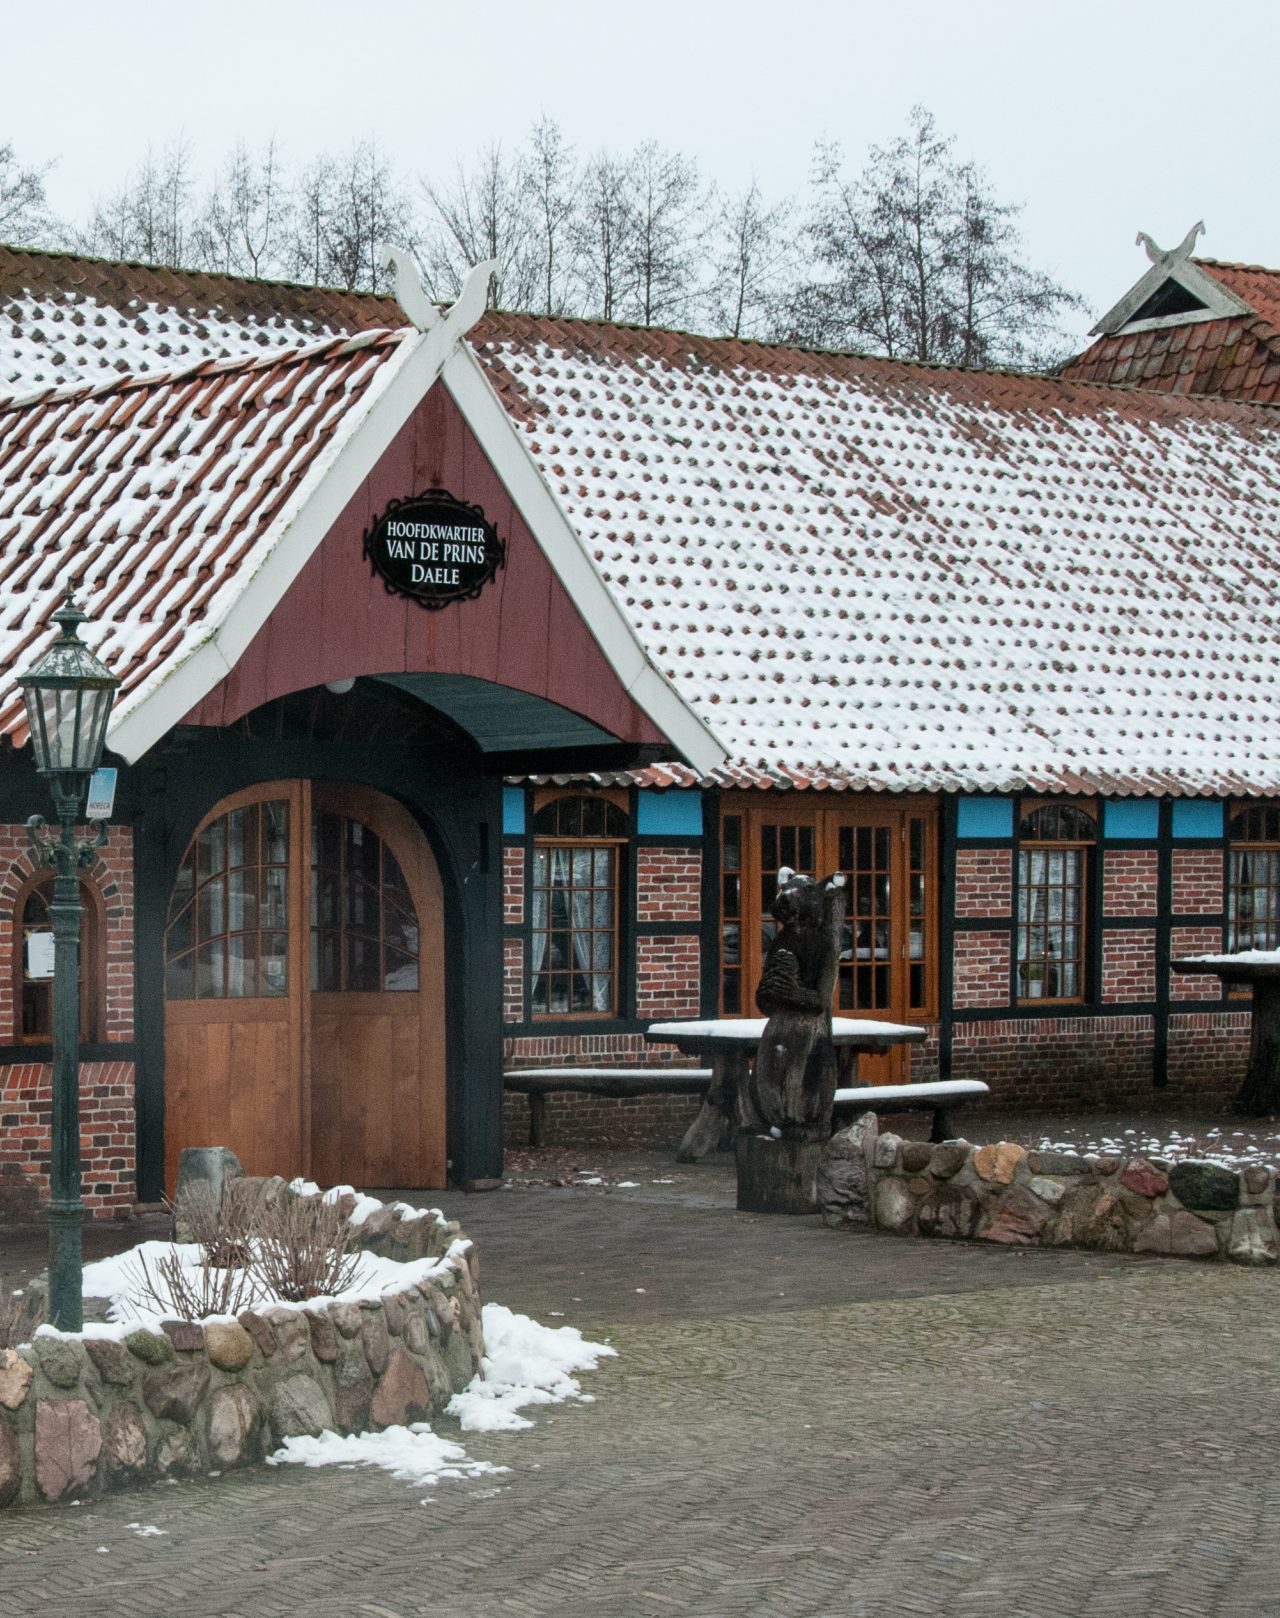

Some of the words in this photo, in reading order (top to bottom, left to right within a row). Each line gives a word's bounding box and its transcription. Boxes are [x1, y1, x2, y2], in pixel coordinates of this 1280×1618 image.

[387, 521, 486, 543] HOOFDKWARTIER
[386, 540, 415, 559] VAN
[420, 542, 439, 561] DE
[443, 544, 485, 564] PRINS
[411, 564, 460, 585] DAELE
